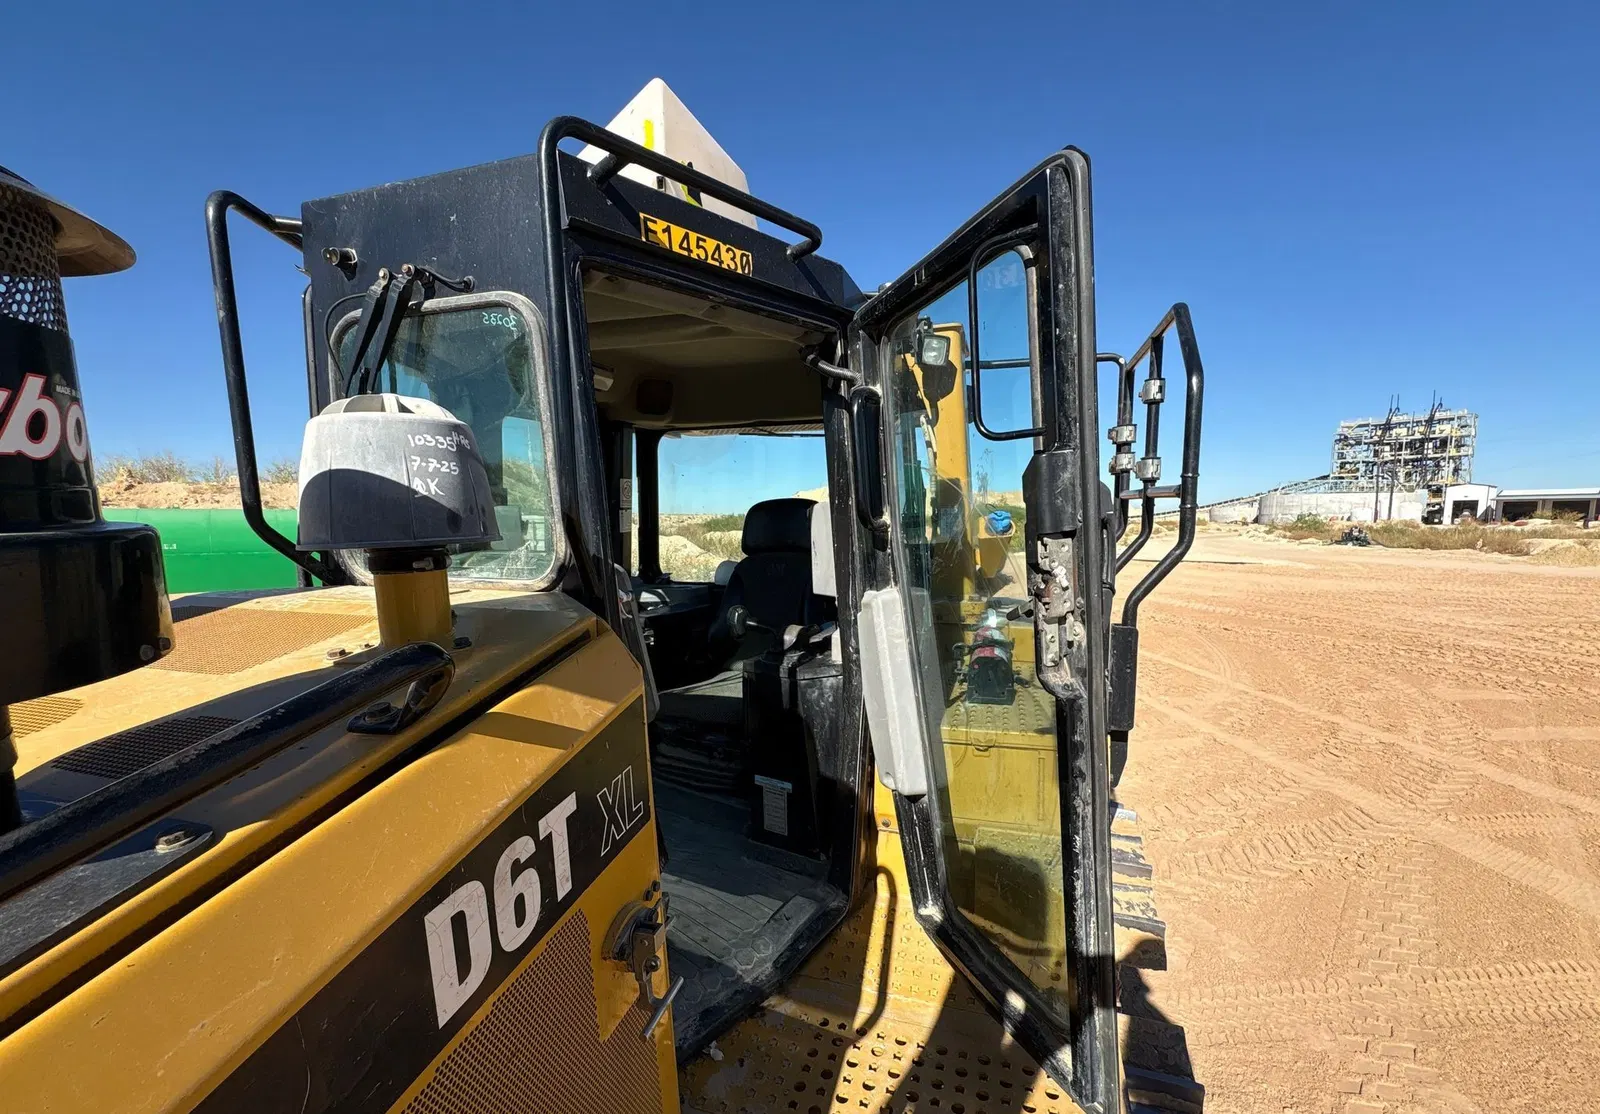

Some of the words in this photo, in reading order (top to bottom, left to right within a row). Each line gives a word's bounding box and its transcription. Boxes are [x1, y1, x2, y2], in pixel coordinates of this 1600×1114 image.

[642, 216, 753, 277] E145430
[0, 372, 88, 464] bo
[55, 384, 71, 396] MADE
[410, 455, 459, 475] 7-7-25
[424, 791, 578, 1030] D6T
[596, 765, 644, 857] XL
